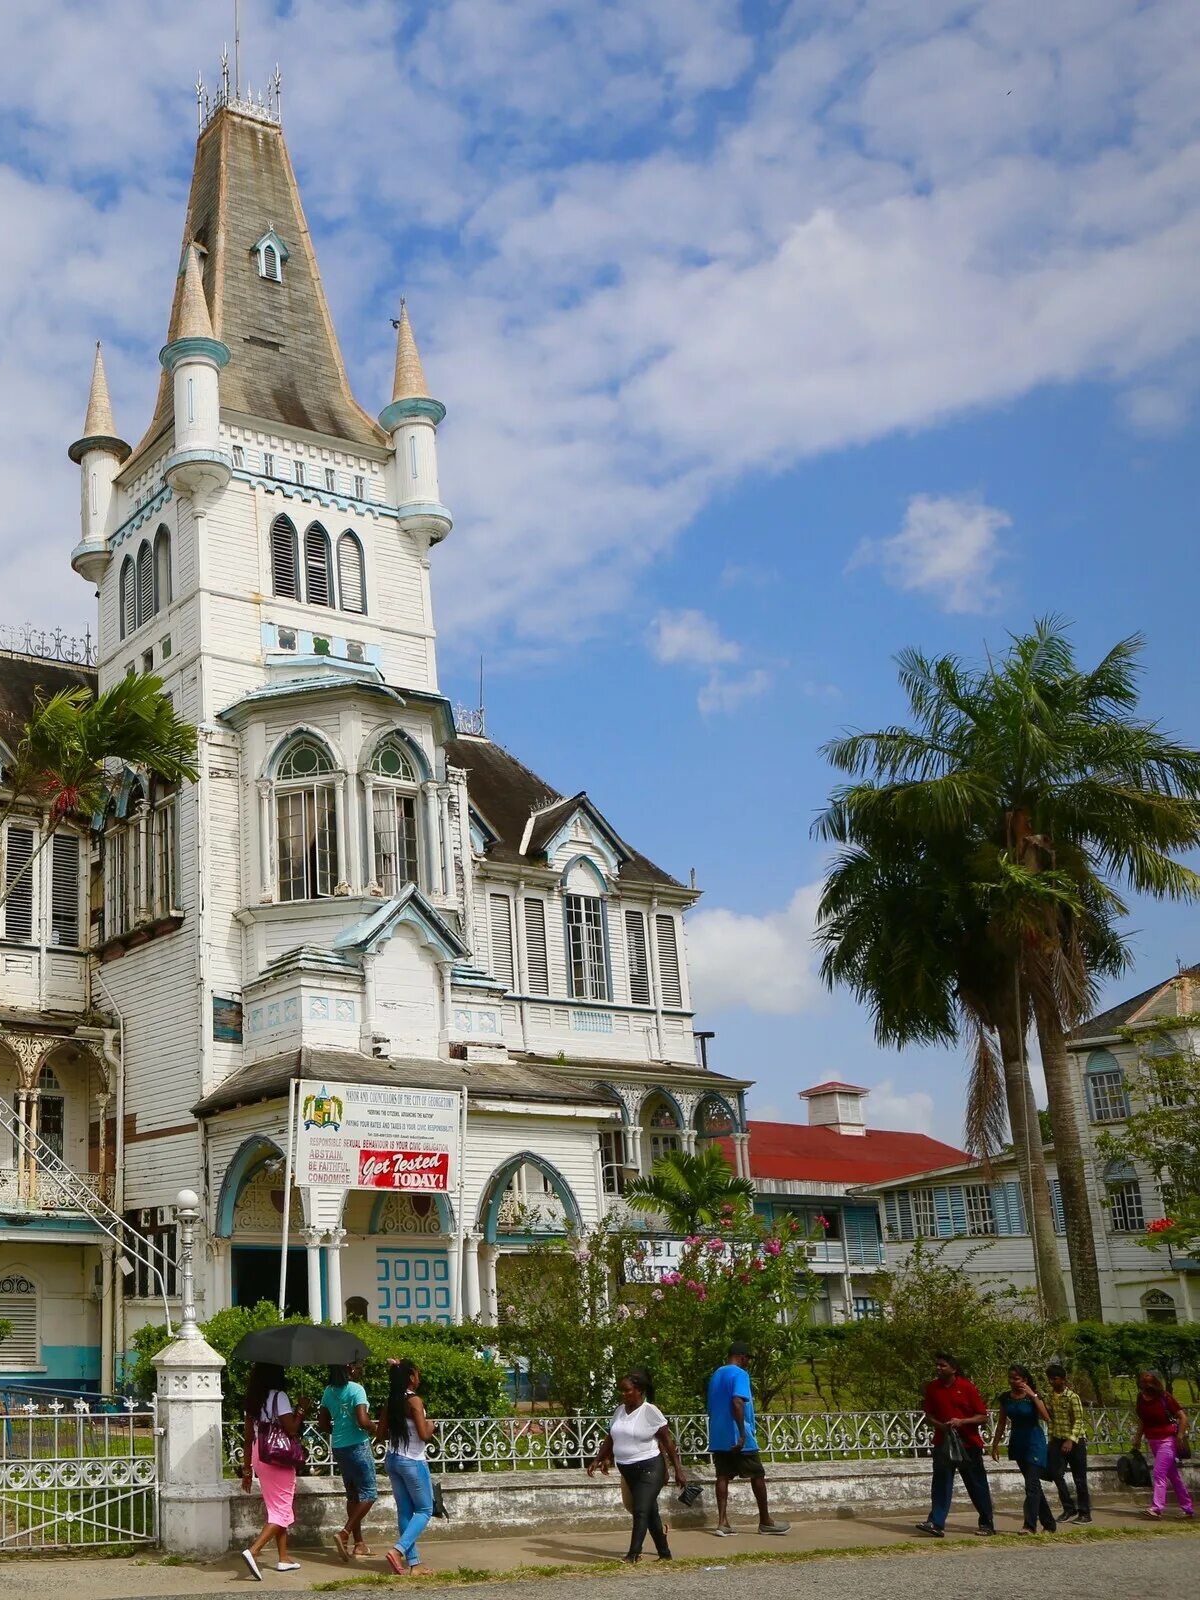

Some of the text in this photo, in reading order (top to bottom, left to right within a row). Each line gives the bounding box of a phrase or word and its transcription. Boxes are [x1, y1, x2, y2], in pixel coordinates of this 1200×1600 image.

[345, 1090, 359, 1102] MAYOR
[360, 1092, 368, 1103] AND
[370, 1092, 397, 1105] COUNCILLORS
[398, 1094, 403, 1105] OF
[413, 1095, 421, 1106] CITY
[422, 1096, 427, 1106] OF
[428, 1096, 454, 1108] GEORGETOWN
[346, 1120, 359, 1128] PAYING
[310, 1137, 342, 1147] RESPONSIBLE
[343, 1139, 361, 1148] SEXUAL
[363, 1139, 389, 1149] BEHAVIOUR
[390, 1140, 395, 1150] IS
[396, 1141, 408, 1150] YOUR
[409, 1142, 421, 1151] CIVIC
[308, 1161, 317, 1170] BE
[362, 1153, 442, 1185] Get Tested
[308, 1173, 351, 1184] CONDOMISE.
[392, 1172, 444, 1188] TODAY!
[634, 1241, 741, 1258] WELCME
